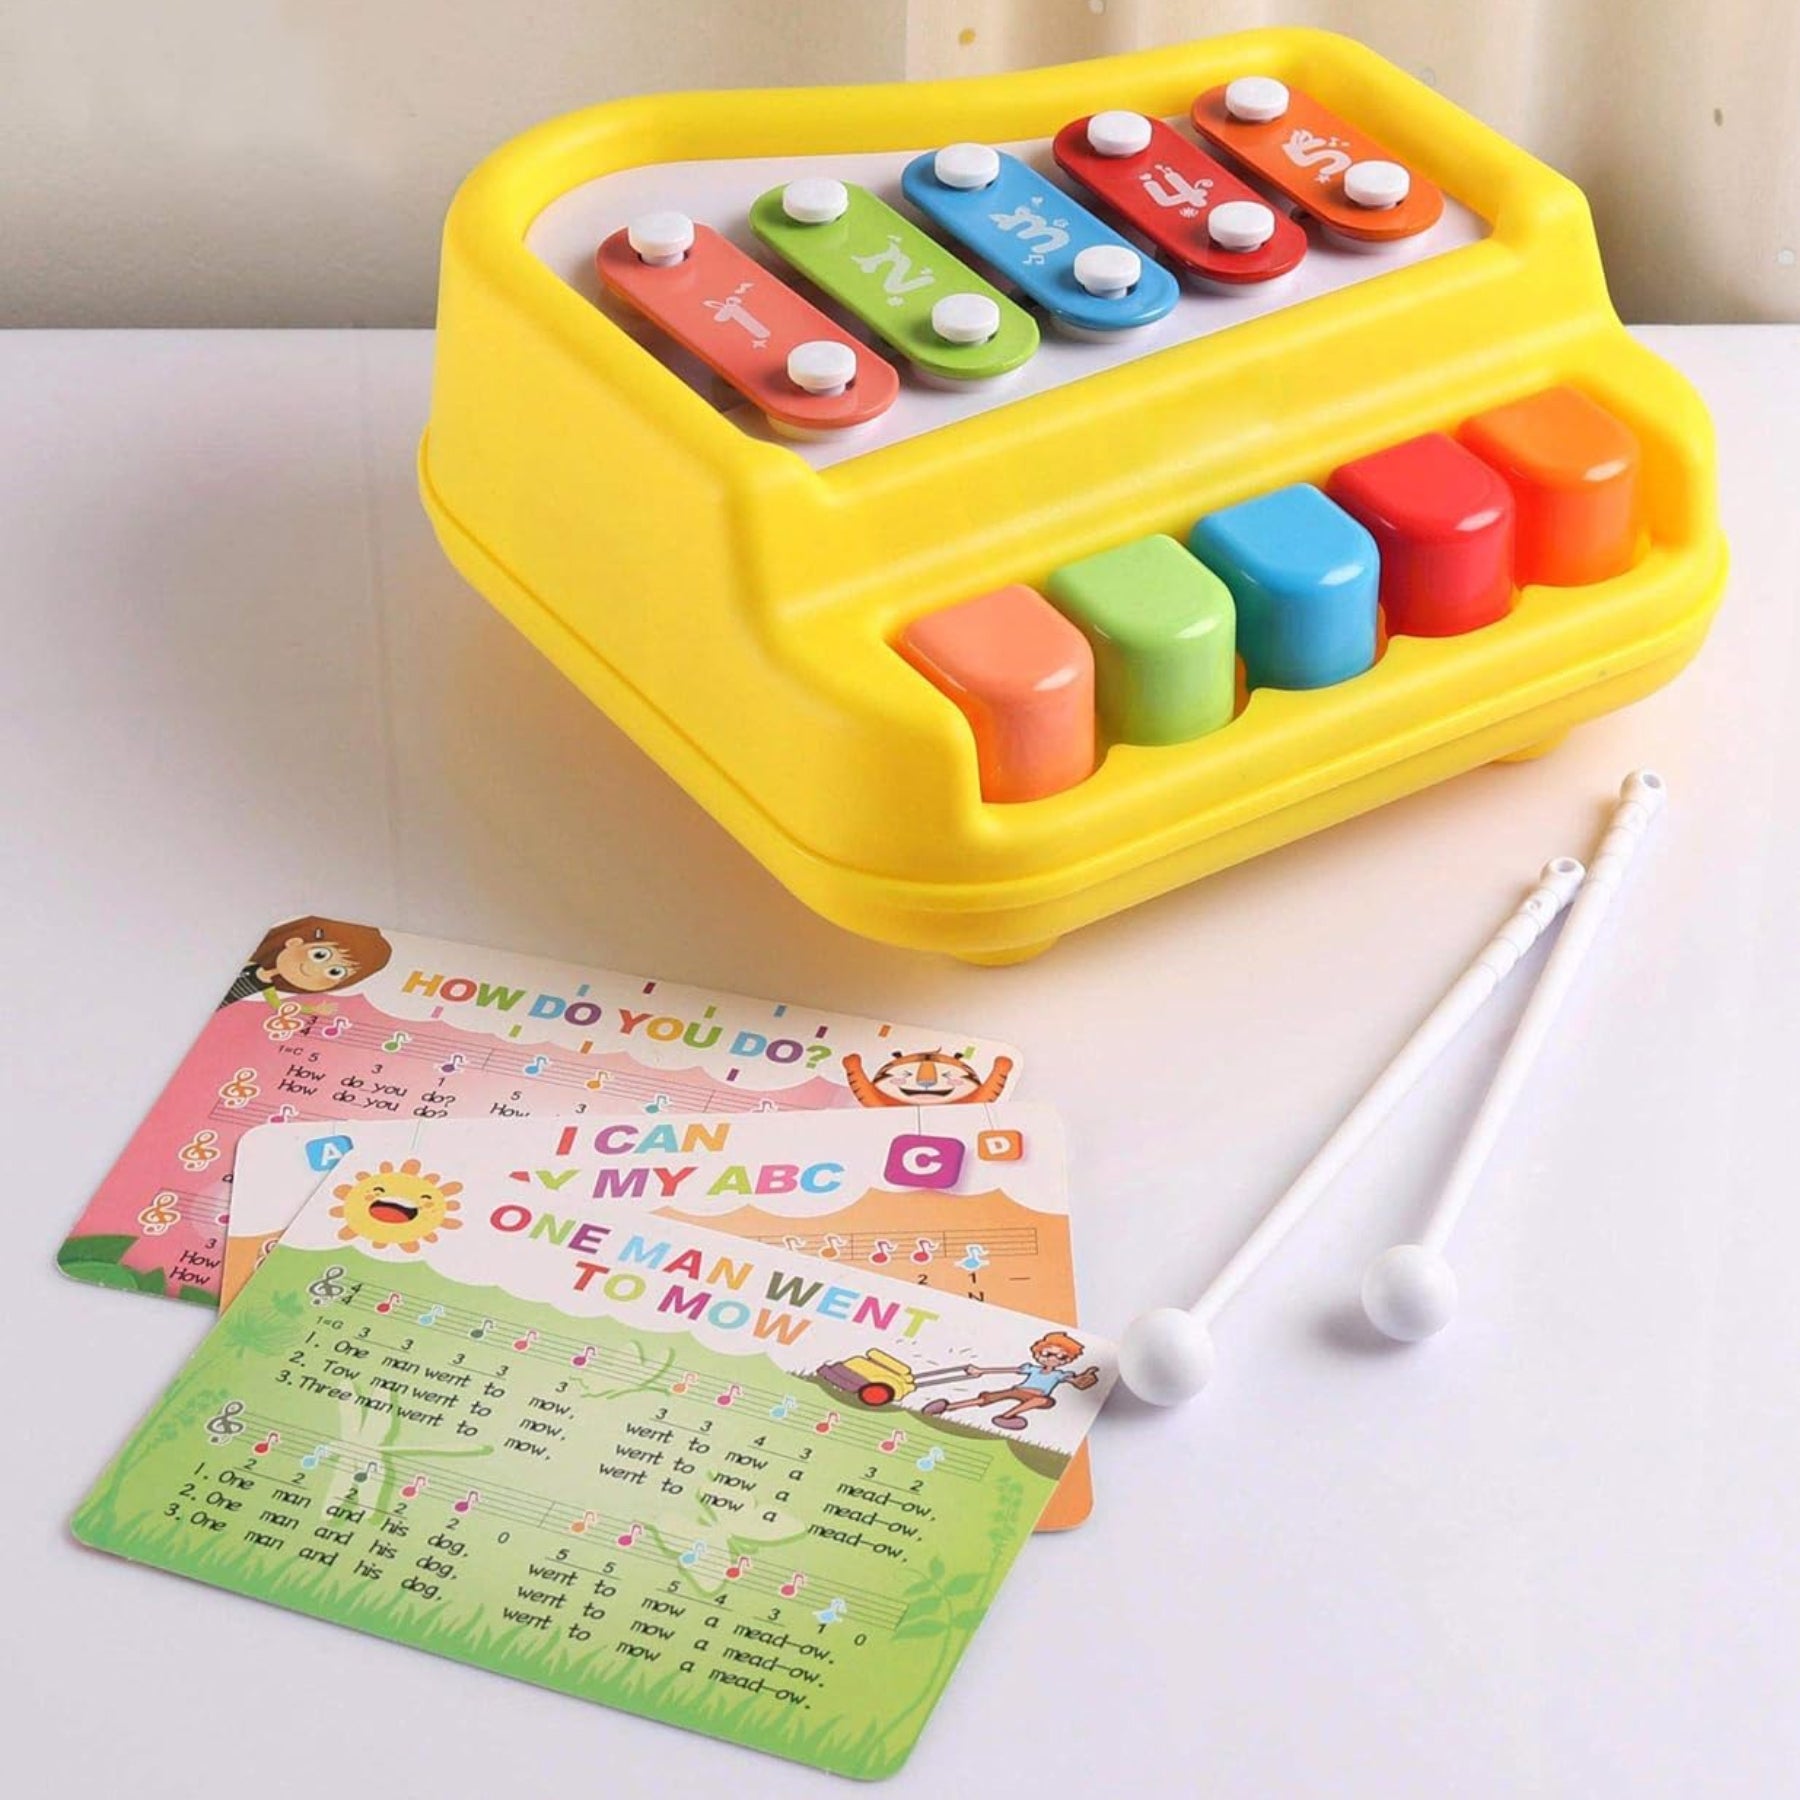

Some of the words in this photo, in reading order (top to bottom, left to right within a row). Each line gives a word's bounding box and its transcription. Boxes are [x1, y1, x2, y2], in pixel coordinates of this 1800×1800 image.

[401, 970, 526, 1012] HOW
[528, 994, 602, 1026] DO
[618, 1008, 723, 1048] YOU
[729, 1030, 832, 1069] DO?
[277, 1079, 318, 1096] How
[286, 1064, 326, 1082] How
[421, 1091, 456, 1108] do?
[308, 1052, 320, 1063] 5
[371, 1064, 383, 1074] 3
[511, 1091, 522, 1101] 5
[575, 1104, 587, 1114] 3
[556, 1126, 578, 1156] I
[594, 1123, 731, 1155] CAN
[592, 1166, 699, 1199] MY
[707, 1163, 846, 1196] ABC
[902, 1146, 942, 1175] C
[984, 1136, 1011, 1155] D
[169, 1266, 211, 1285] How
[179, 1250, 221, 1269] How
[489, 1204, 611, 1255] ONE
[618, 1235, 753, 1290] MAN
[765, 1271, 940, 1338] WENT
[917, 1274, 928, 1285] 2
[968, 1272, 977, 1284] 1
[573, 1261, 646, 1302] TO
[657, 1285, 811, 1346] MOW
[275, 1369, 293, 1386] 3.
[299, 1375, 353, 1401] Three
[354, 1395, 393, 1414] man
[397, 1406, 444, 1428] went
[456, 1420, 478, 1437] to
[599, 1463, 648, 1486] went
[661, 1478, 684, 1495] to
[699, 1493, 745, 1512] mow
[762, 1510, 778, 1523] a
[288, 1350, 306, 1367] 2.
[323, 1359, 361, 1380] Tow
[370, 1376, 409, 1394] man
[412, 1386, 460, 1408] went
[470, 1401, 492, 1417] to
[615, 1444, 664, 1465] went
[672, 1457, 696, 1474] to
[712, 1472, 757, 1492] mow
[775, 1490, 791, 1502] a
[334, 1340, 370, 1359] One
[381, 1356, 420, 1375] man
[425, 1366, 472, 1388] went
[483, 1381, 506, 1398] to
[626, 1422, 675, 1444] went
[688, 1437, 711, 1454] to
[724, 1451, 769, 1470] mow
[788, 1469, 804, 1481] a
[358, 1327, 371, 1338] 3
[401, 1338, 414, 1350] 3
[452, 1353, 466, 1365] 3
[496, 1365, 509, 1377] 3
[555, 1382, 568, 1393] 3
[655, 1408, 668, 1420] 3
[700, 1420, 713, 1432] 3
[754, 1436, 767, 1447] 4
[799, 1448, 813, 1460] 3
[864, 1467, 878, 1479] 3
[909, 1480, 924, 1492] 2
[163, 1502, 181, 1521] 3.
[190, 1510, 227, 1532] One
[243, 1530, 285, 1551] man
[299, 1547, 339, 1567] and
[353, 1560, 384, 1581] his
[502, 1607, 553, 1631] went
[568, 1623, 591, 1642] to
[615, 1641, 662, 1662] mow
[679, 1660, 695, 1673] a
[179, 1483, 196, 1501] 2.
[206, 1491, 243, 1512] One
[259, 1510, 299, 1530] man
[314, 1526, 355, 1546] and
[368, 1539, 398, 1560] his
[517, 1585, 567, 1609] went
[582, 1602, 606, 1620] to
[630, 1620, 676, 1640] mow
[694, 1639, 710, 1651] a
[218, 1470, 255, 1491] One
[272, 1489, 312, 1509] man
[326, 1504, 366, 1524] and
[380, 1518, 410, 1537] his
[528, 1563, 579, 1587] went
[593, 1579, 617, 1598] to
[641, 1597, 687, 1618] mow
[704, 1616, 720, 1629] a
[244, 1458, 258, 1470] 2
[291, 1472, 306, 1485] 2
[344, 1488, 358, 1501] 2
[393, 1503, 408, 1516] 2
[445, 1518, 460, 1531] 2
[497, 1531, 510, 1544] 0
[555, 1548, 570, 1561] 5
[602, 1562, 617, 1574] 5
[667, 1580, 681, 1593] 5
[714, 1594, 728, 1605] 4
[767, 1608, 781, 1621] 3
[818, 1623, 828, 1635] 1
[854, 1634, 867, 1646] 0
